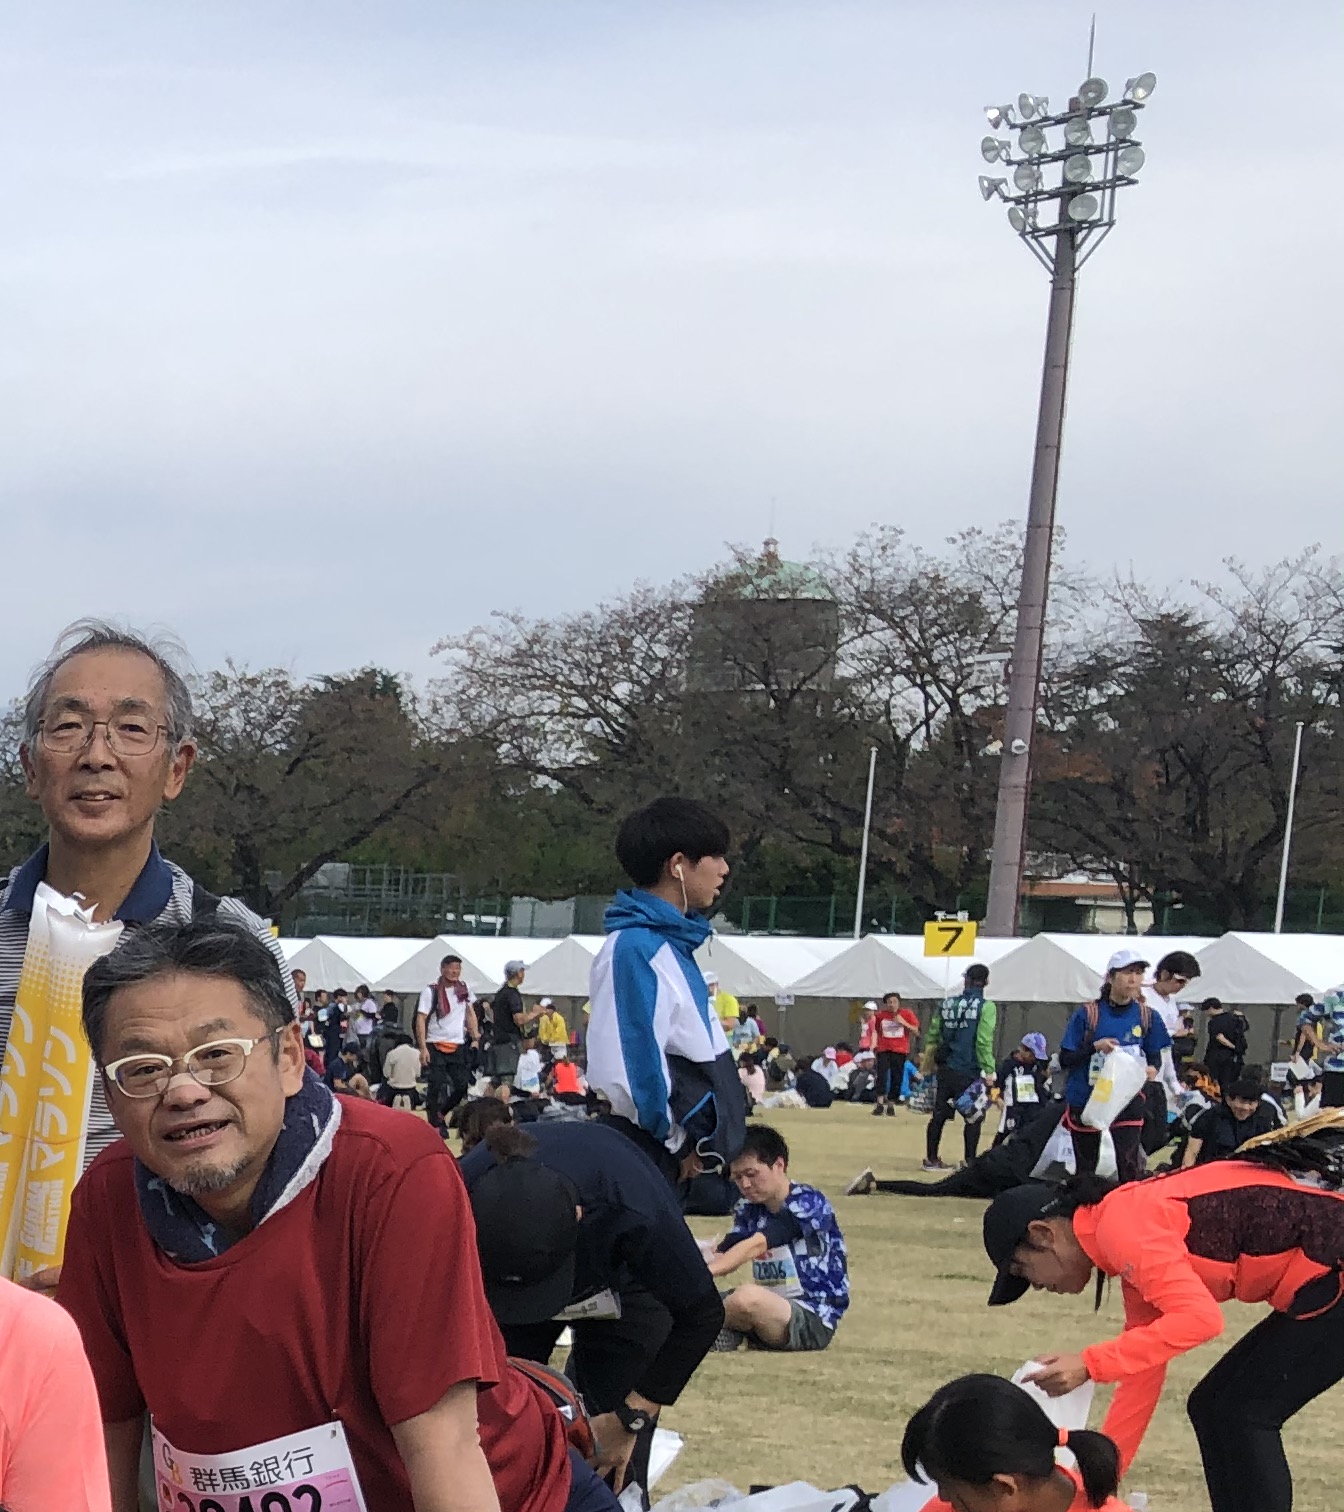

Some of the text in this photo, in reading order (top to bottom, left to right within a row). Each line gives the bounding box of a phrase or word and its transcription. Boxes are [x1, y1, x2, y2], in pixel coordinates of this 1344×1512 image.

[937, 926, 964, 952] 7
[29, 1025, 77, 1171] マラソン
[189, 1446, 314, 1492] 群馬銀行
